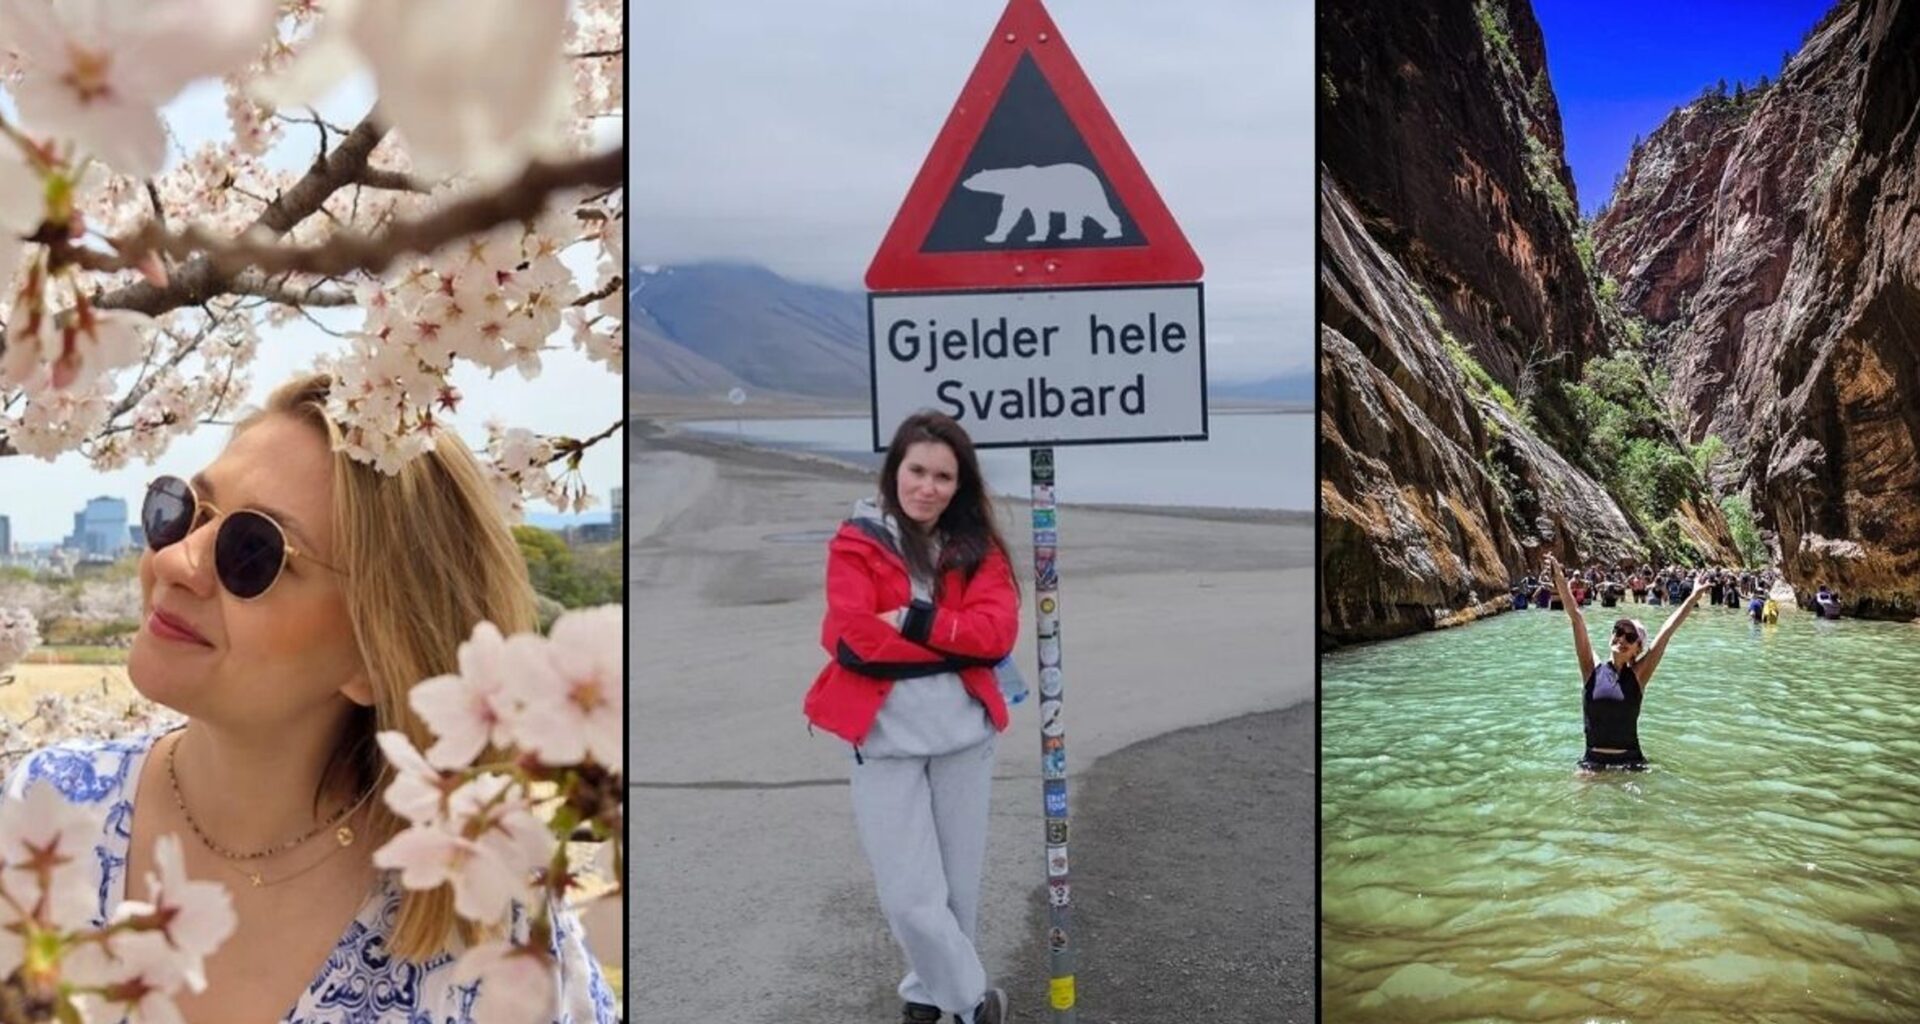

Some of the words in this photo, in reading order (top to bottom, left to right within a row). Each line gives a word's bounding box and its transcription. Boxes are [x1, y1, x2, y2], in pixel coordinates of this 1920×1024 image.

[887, 316, 1060, 373] Gjelder
[1089, 312, 1187, 355] hele
[936, 373, 1146, 421] Svalbard
